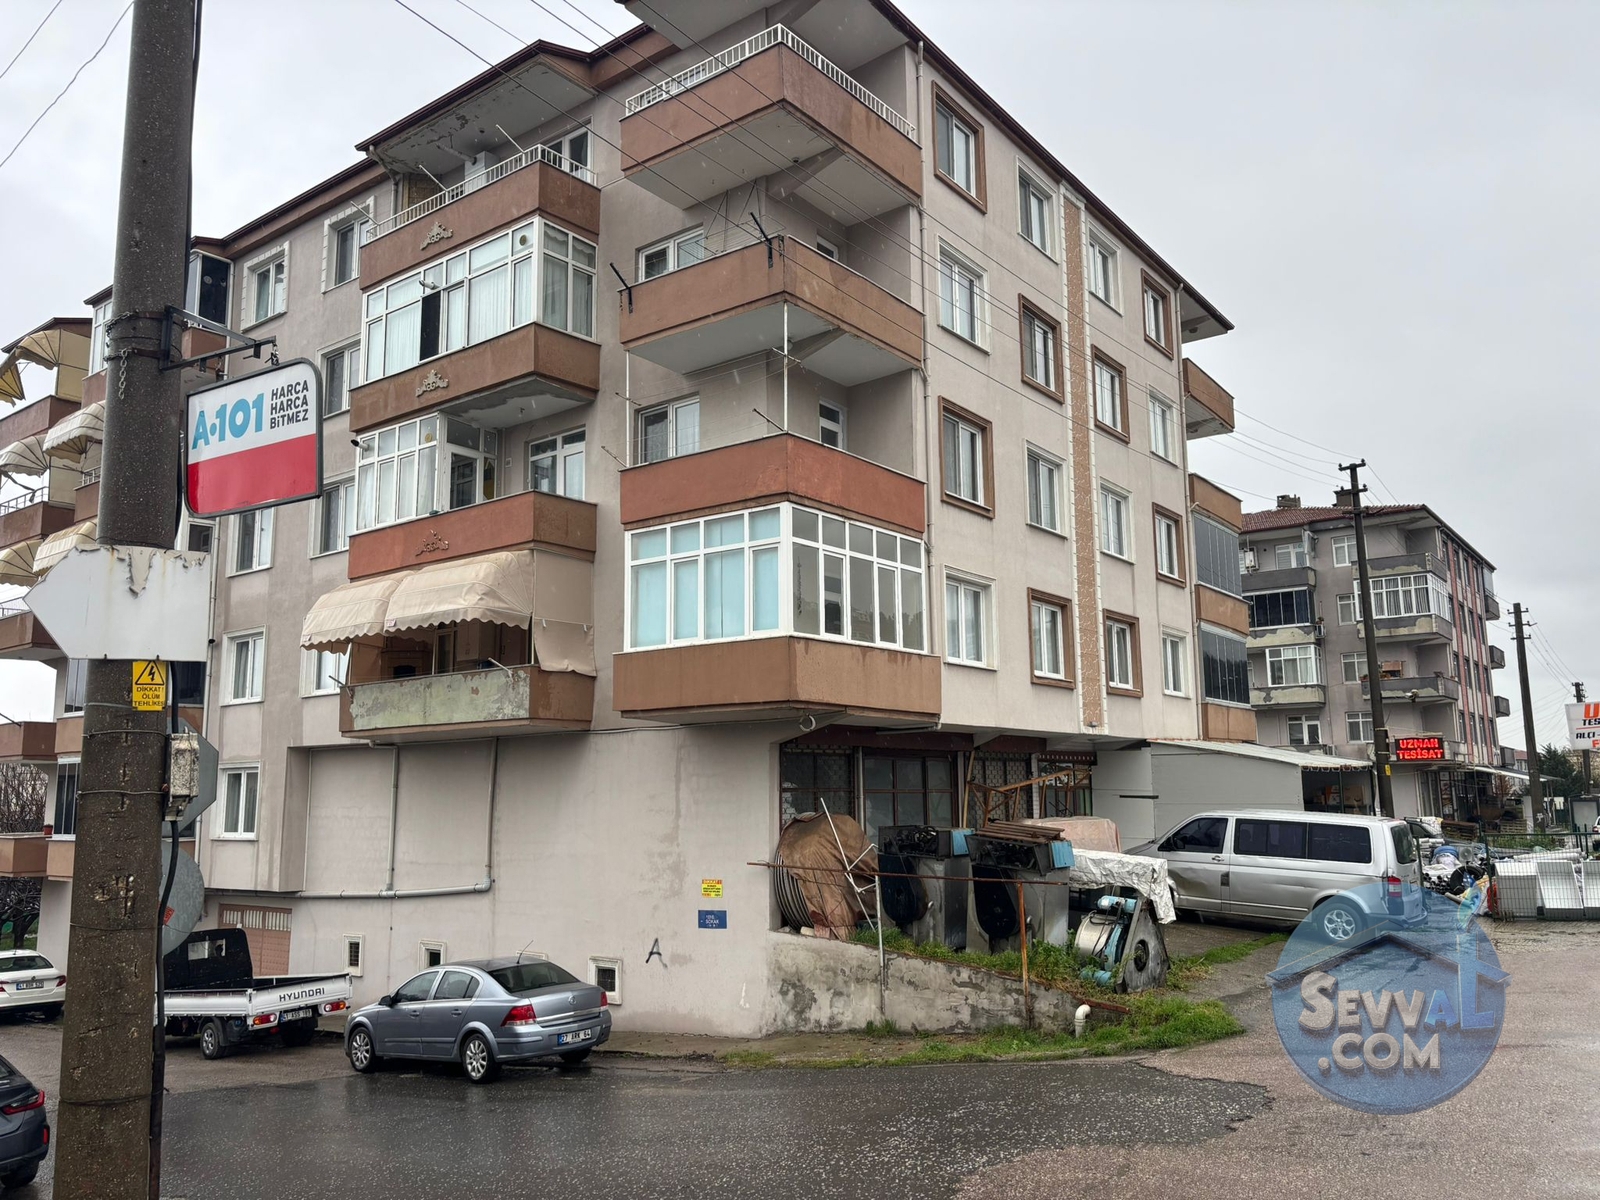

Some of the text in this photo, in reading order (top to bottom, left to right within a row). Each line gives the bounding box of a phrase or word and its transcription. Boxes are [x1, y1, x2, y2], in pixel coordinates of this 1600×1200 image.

[271, 380, 309, 401] HARCA
[270, 395, 308, 415] HARCA
[1399, 739, 1439, 748] UZMAN
[1396, 748, 1443, 759] TESİSAT
[645, 938, 668, 969] A
[279, 988, 325, 1002] HYUNDAI
